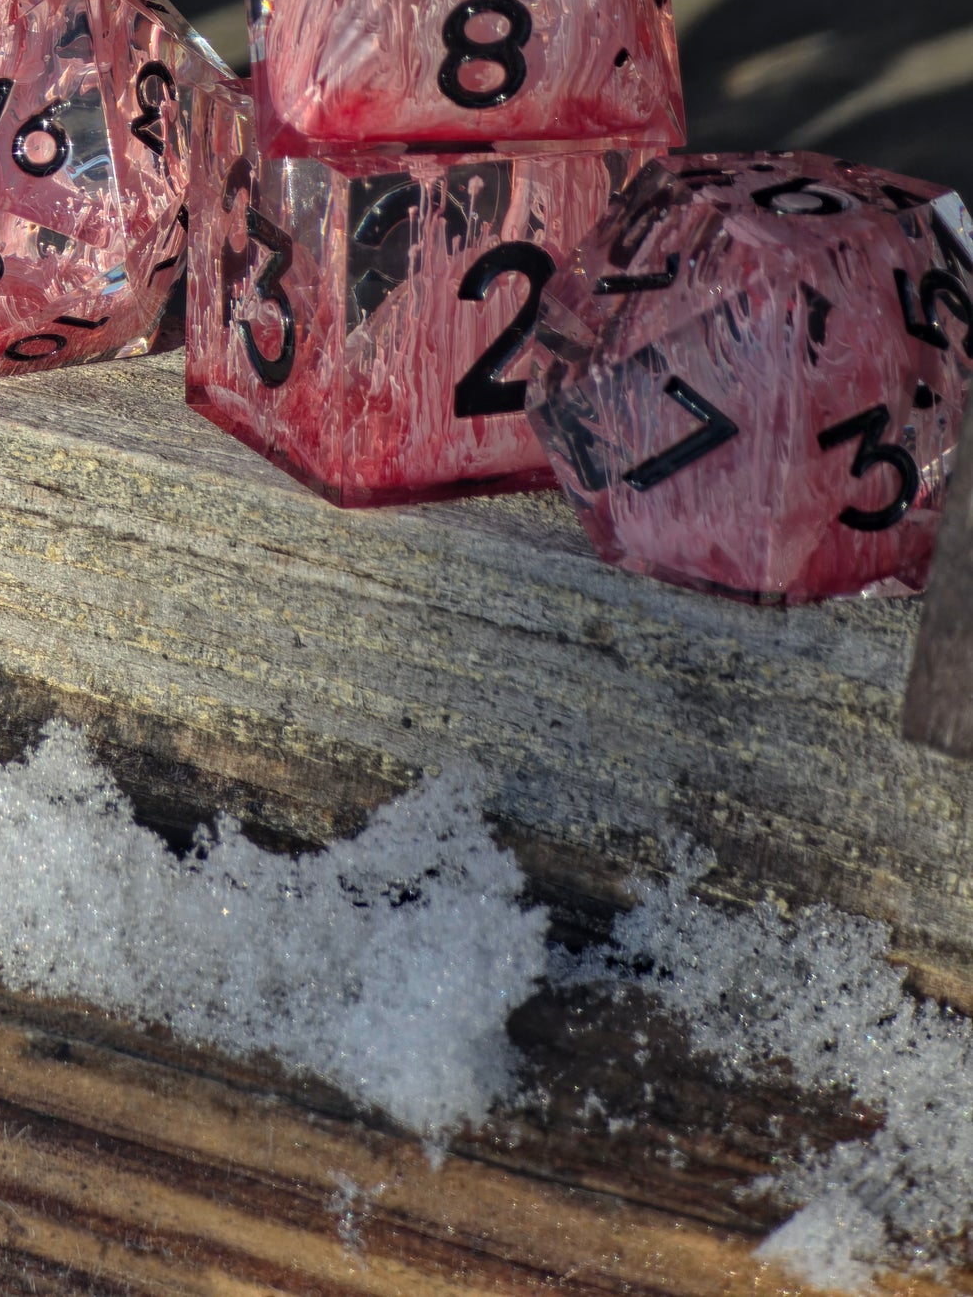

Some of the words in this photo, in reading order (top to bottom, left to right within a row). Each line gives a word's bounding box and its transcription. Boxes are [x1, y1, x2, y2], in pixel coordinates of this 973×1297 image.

[247, 206, 296, 389] 3
[454, 239, 558, 418] 2
[623, 374, 739, 493] 7
[818, 404, 919, 531] 3
